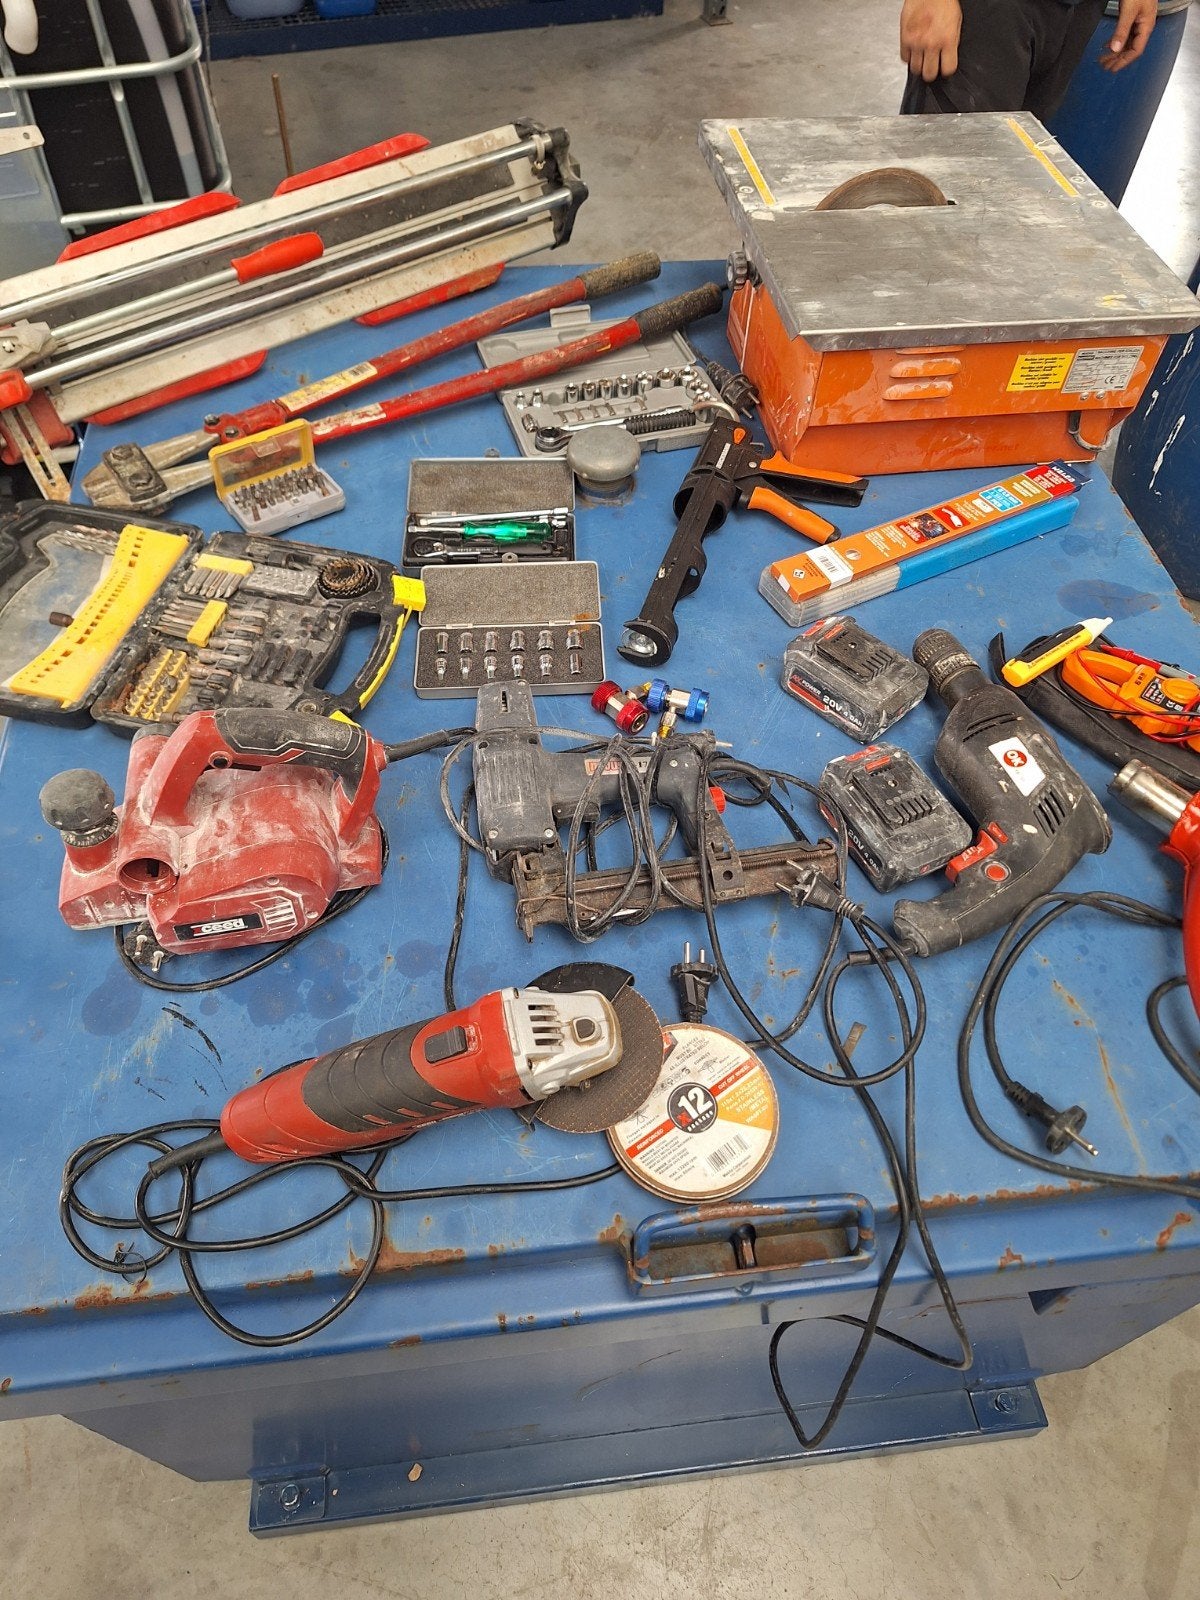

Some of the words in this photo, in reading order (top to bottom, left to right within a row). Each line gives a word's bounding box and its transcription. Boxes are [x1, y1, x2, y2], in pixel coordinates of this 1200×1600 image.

[802, 680, 821, 695] POWER
[823, 695, 842, 712] 20V
[848, 829, 864, 850] 20V
